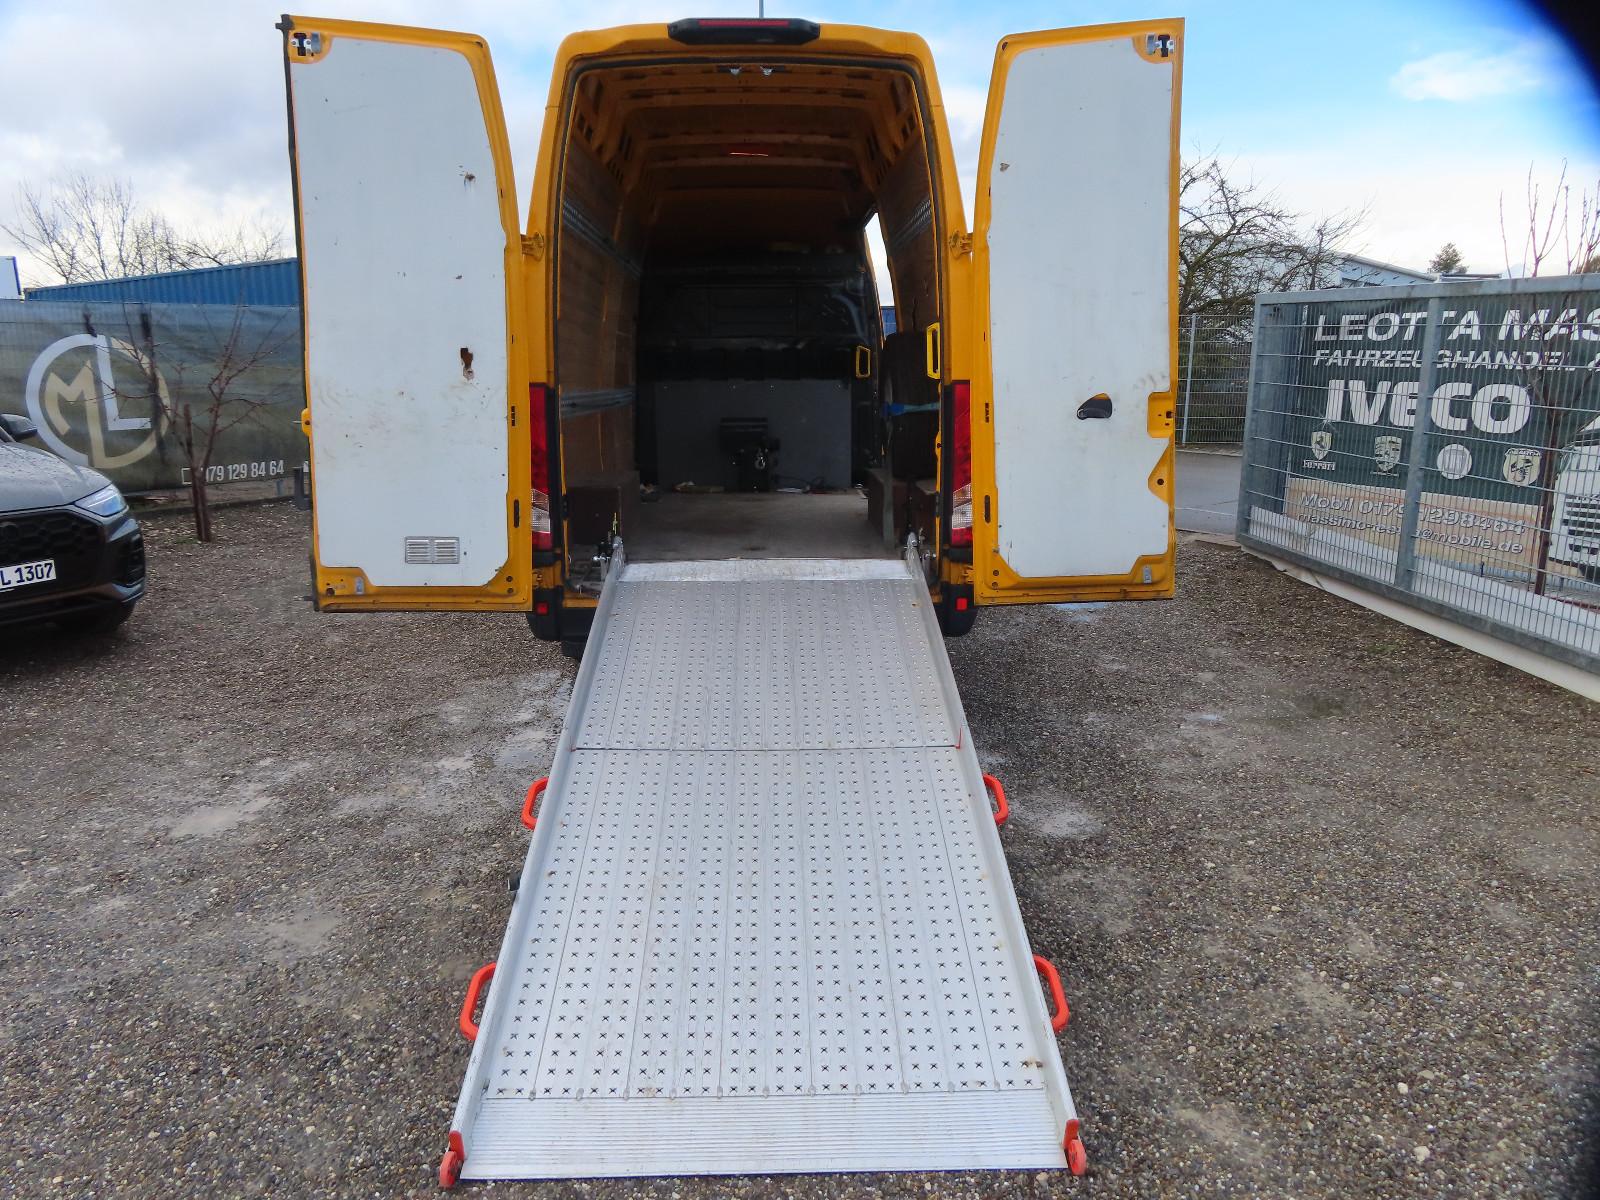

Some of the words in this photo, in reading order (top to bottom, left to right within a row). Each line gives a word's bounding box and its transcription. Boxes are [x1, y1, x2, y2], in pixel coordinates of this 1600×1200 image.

[1325, 379, 1531, 434] IVECO
[227, 464, 248, 480] 129
[251, 462, 266, 477] 84
[269, 460, 284, 475] 64
[1300, 492, 1354, 512] Mobil
[14, 562, 53, 583] 1307
